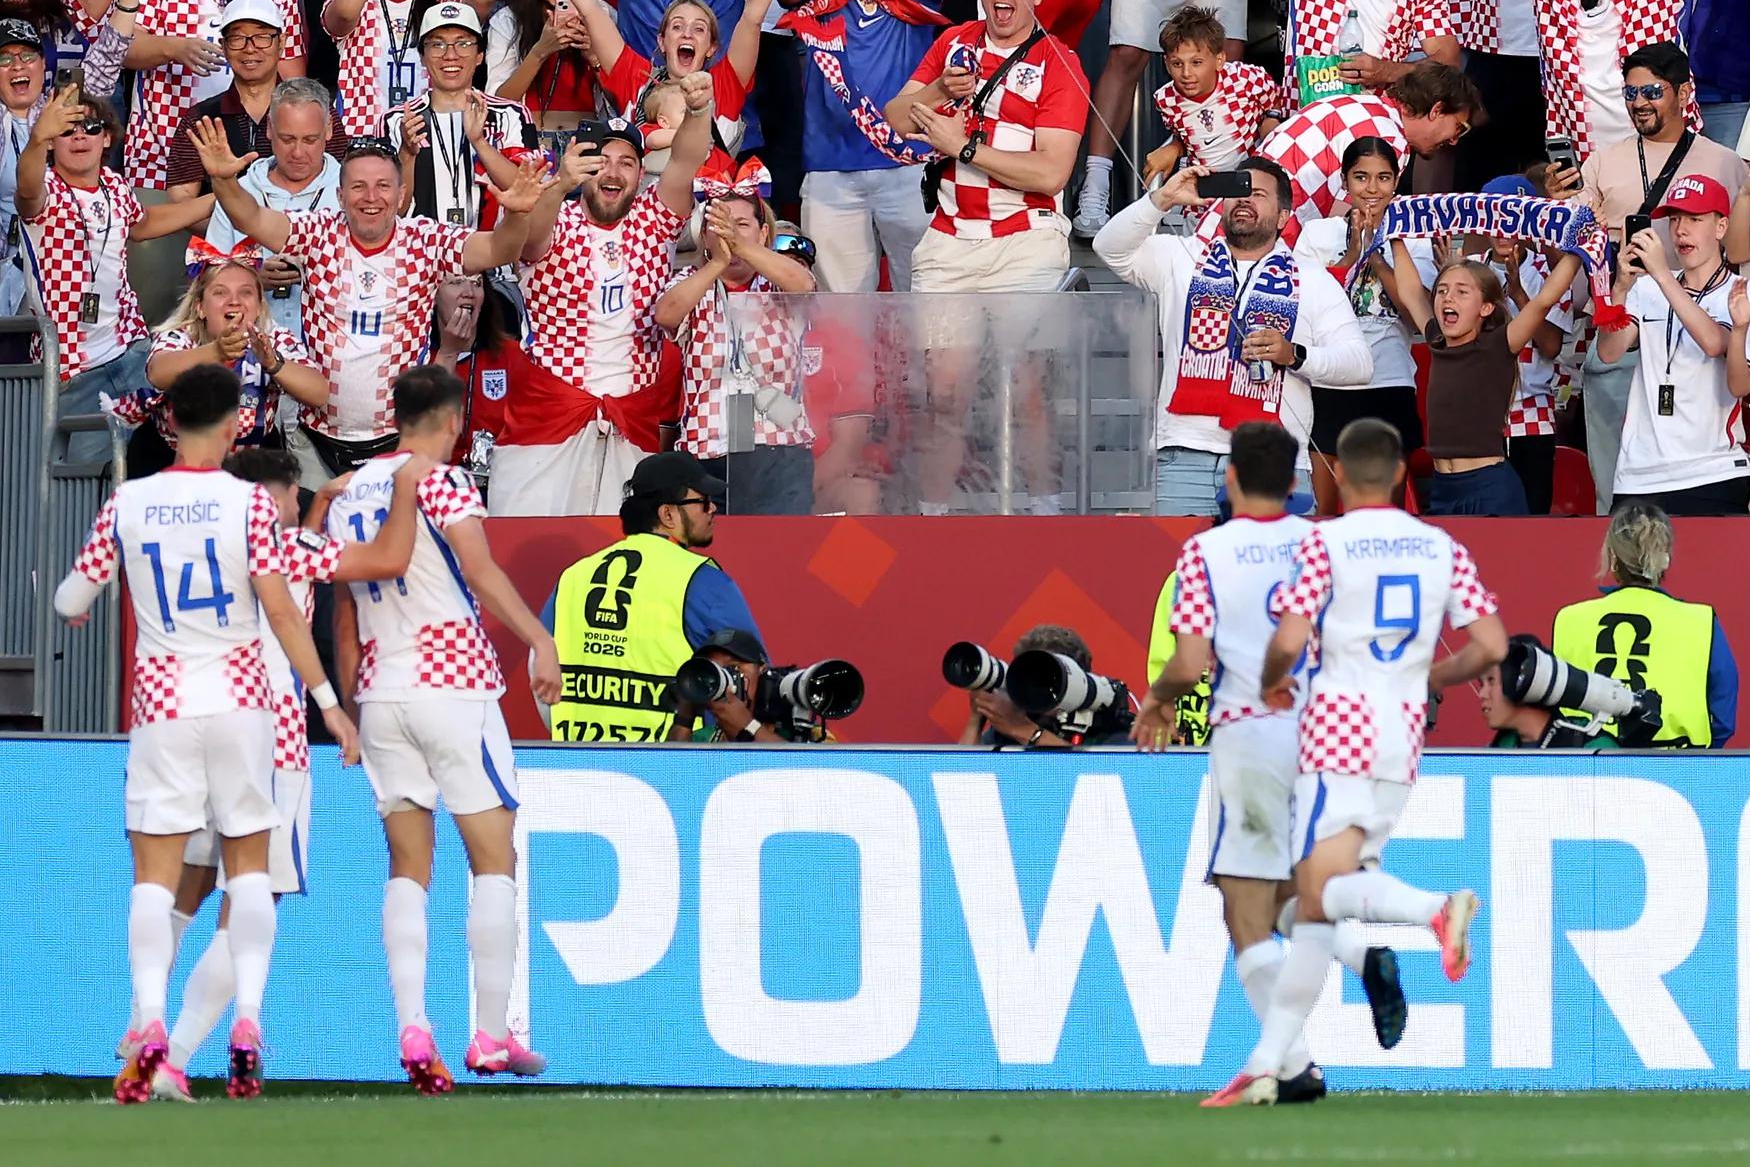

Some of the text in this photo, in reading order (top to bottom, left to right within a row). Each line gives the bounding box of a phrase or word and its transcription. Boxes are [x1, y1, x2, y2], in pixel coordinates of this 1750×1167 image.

[1314, 82, 1344, 94] CORN
[1388, 193, 1573, 244] HRVATSKA
[601, 285, 624, 315] 10
[1181, 344, 1230, 381] CROATIA
[142, 537, 234, 633] 14
[595, 610, 618, 624] FIFA
[1369, 574, 1420, 663] 9
[583, 643, 625, 657] 2026
[611, 635, 628, 643] CUP
[561, 670, 667, 708] ECURITY
